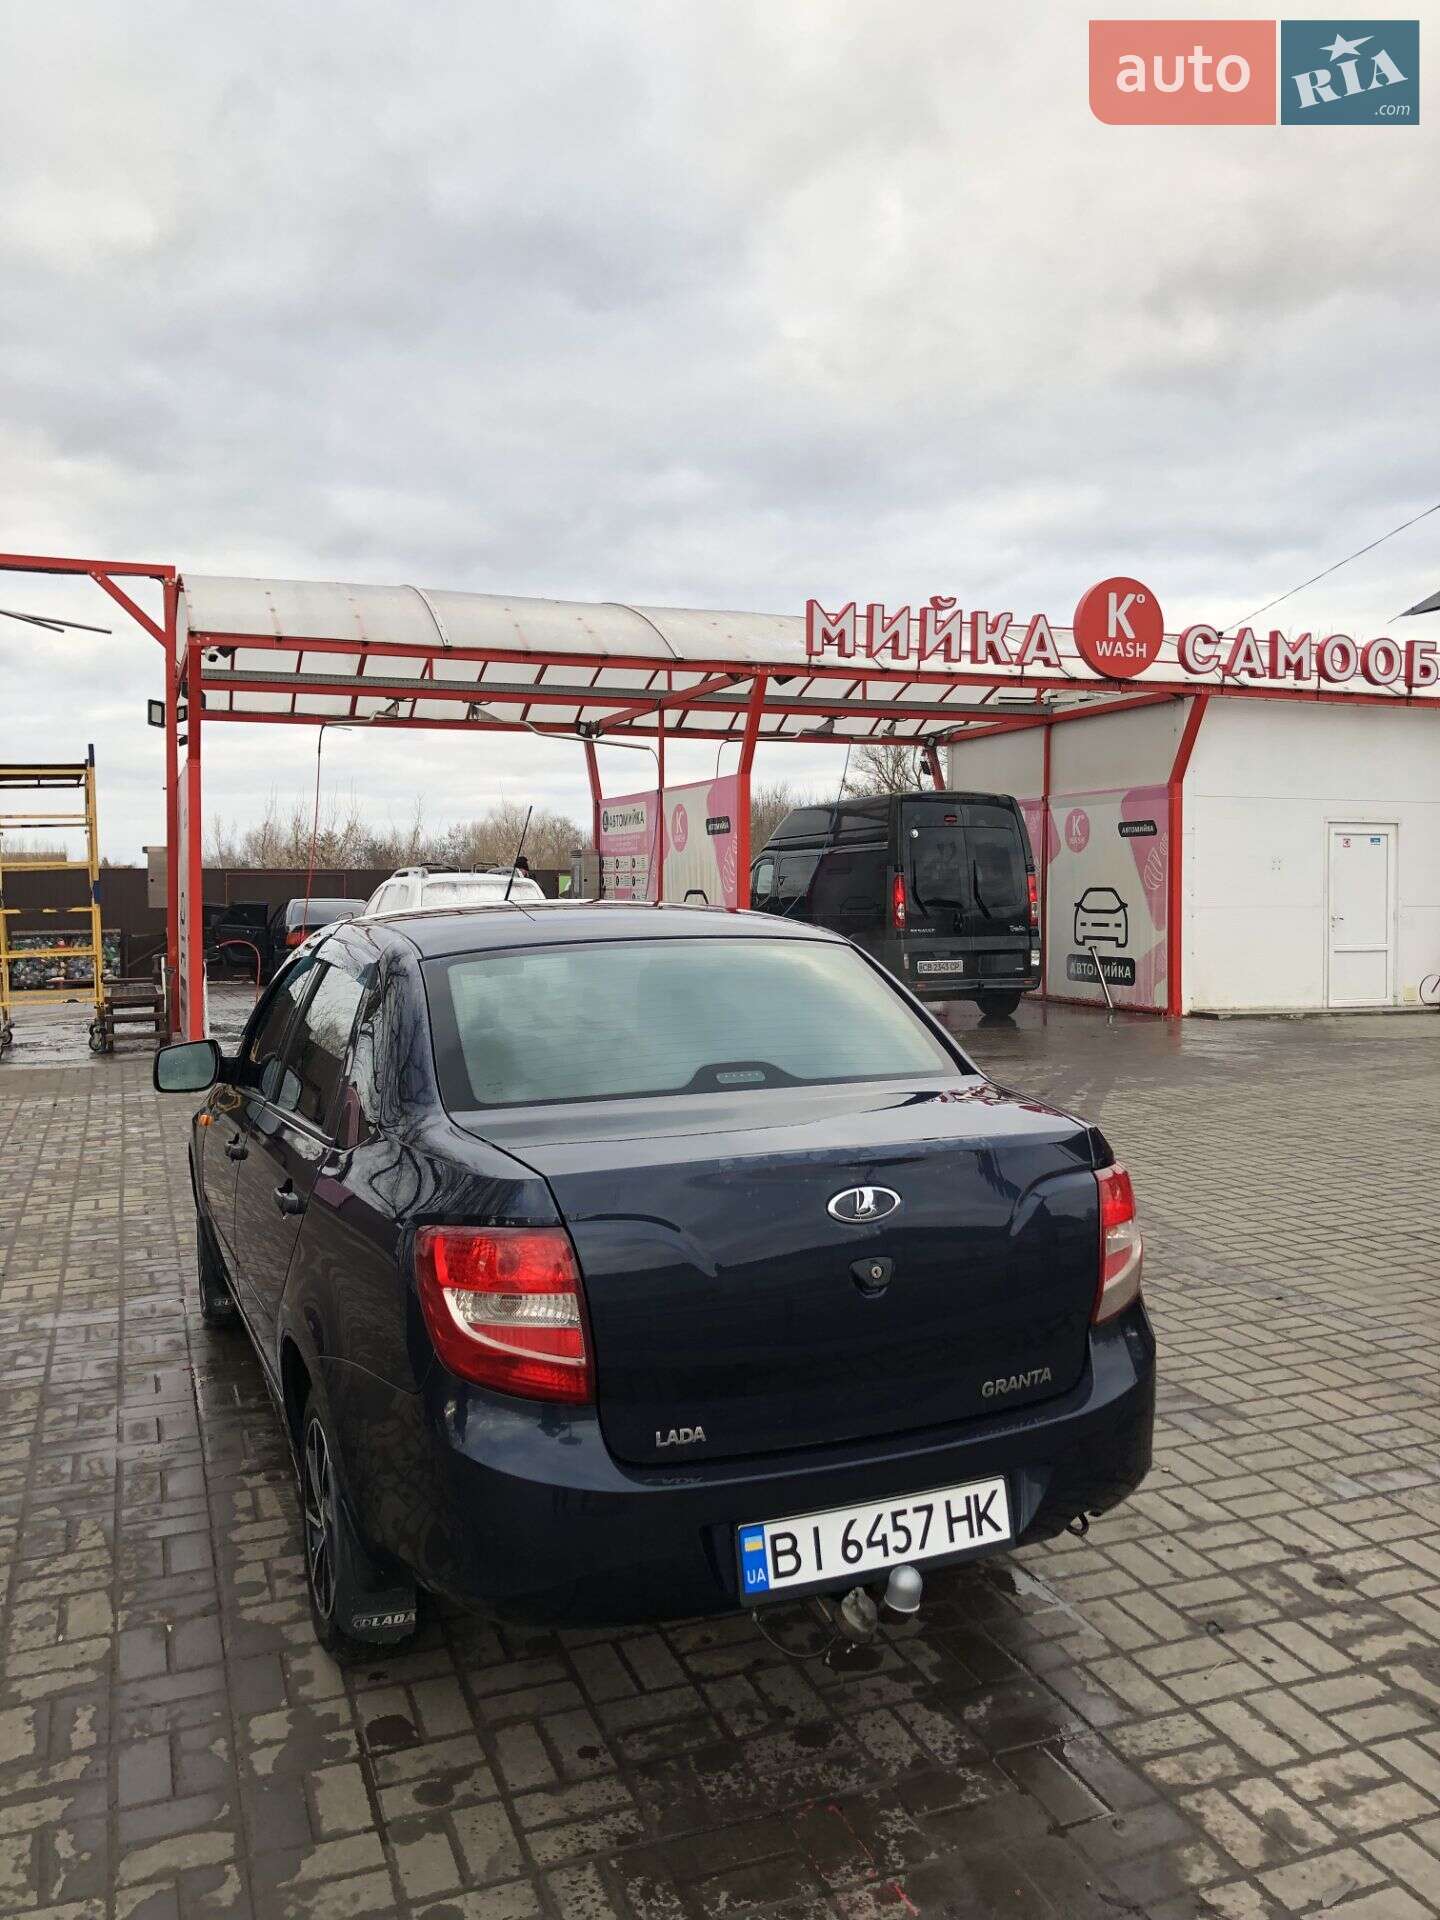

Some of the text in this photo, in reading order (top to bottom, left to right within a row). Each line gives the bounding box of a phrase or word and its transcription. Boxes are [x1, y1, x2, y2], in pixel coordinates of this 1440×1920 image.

[806, 596, 1439, 688] МИЙКА САМООБ
[1095, 641, 1147, 658] WASH
[981, 1367, 1052, 1398] GRANTA
[655, 1426, 706, 1447] LADA
[747, 1489, 1003, 1585] UA BI 6457 HK
[372, 1612, 416, 1627] LADA
